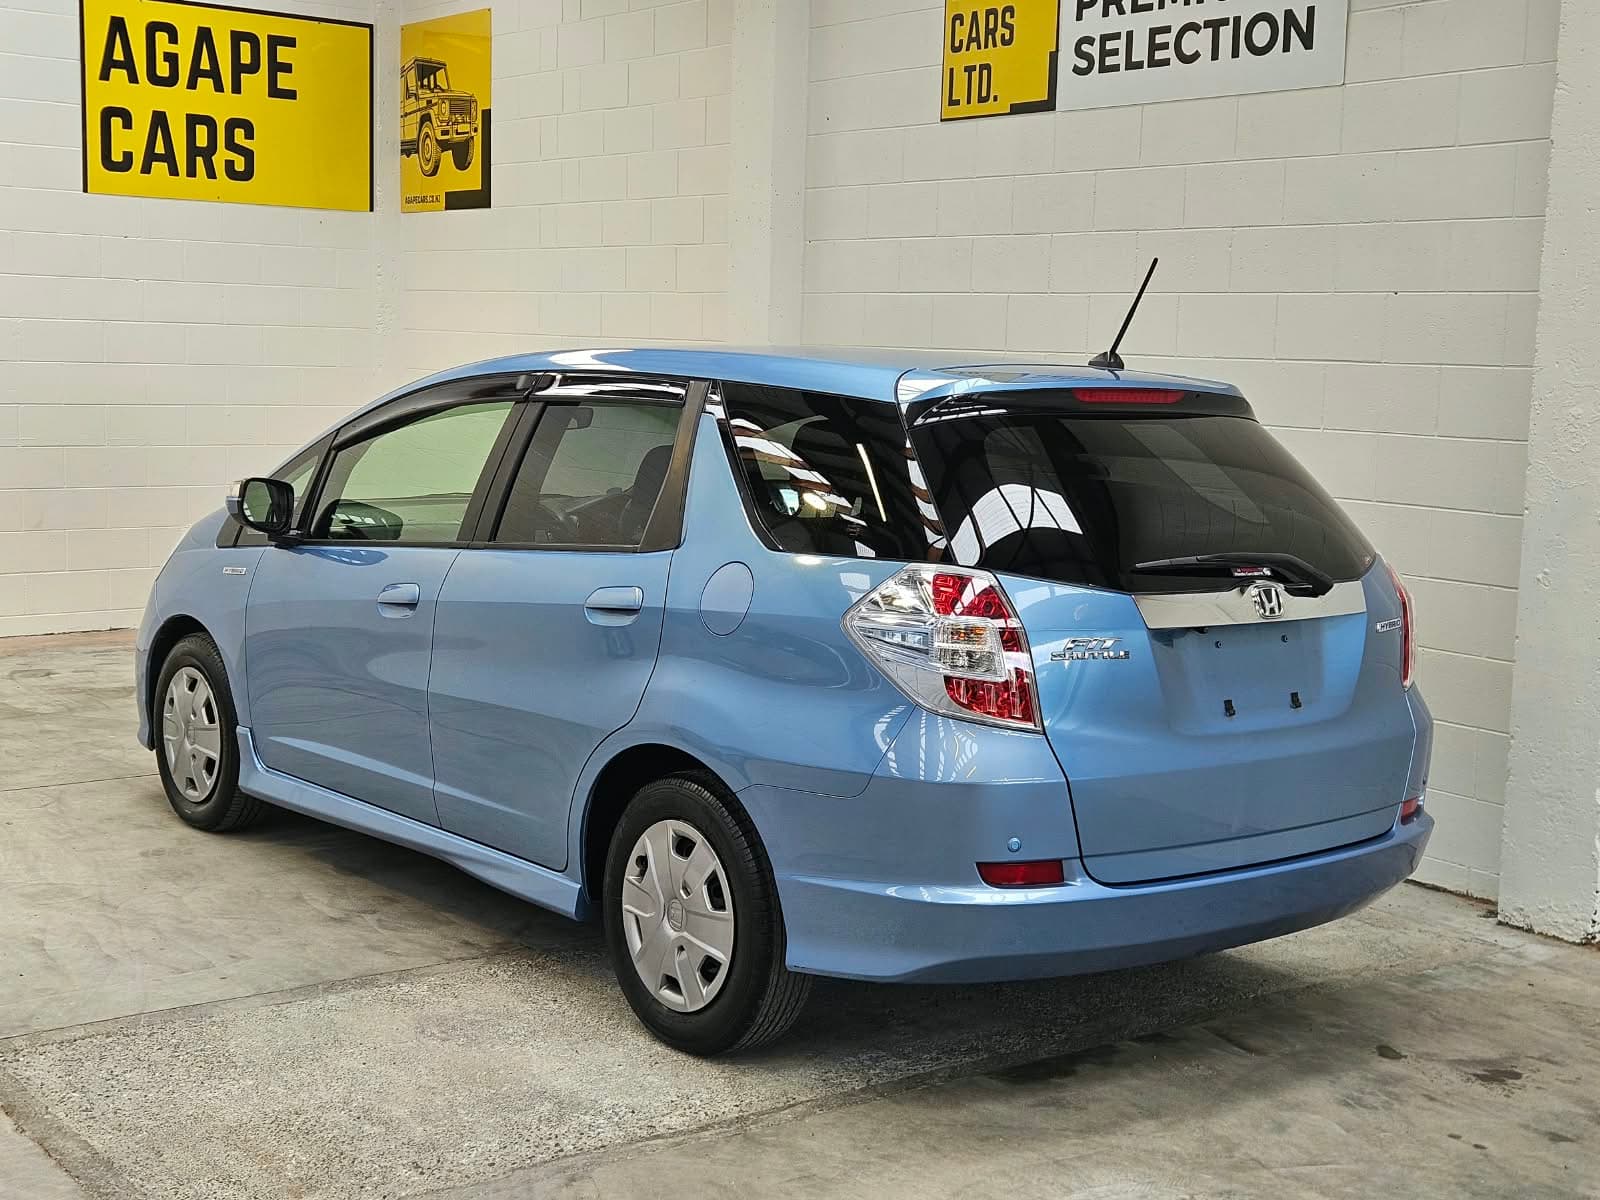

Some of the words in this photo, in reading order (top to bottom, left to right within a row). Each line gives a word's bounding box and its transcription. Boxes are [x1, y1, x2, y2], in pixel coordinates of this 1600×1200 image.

[99, 15, 298, 100] AGAPE
[951, 5, 1015, 53] CARS
[1072, 5, 1316, 76] SELECTION
[948, 63, 998, 107] LTD.
[100, 105, 255, 182] CARS
